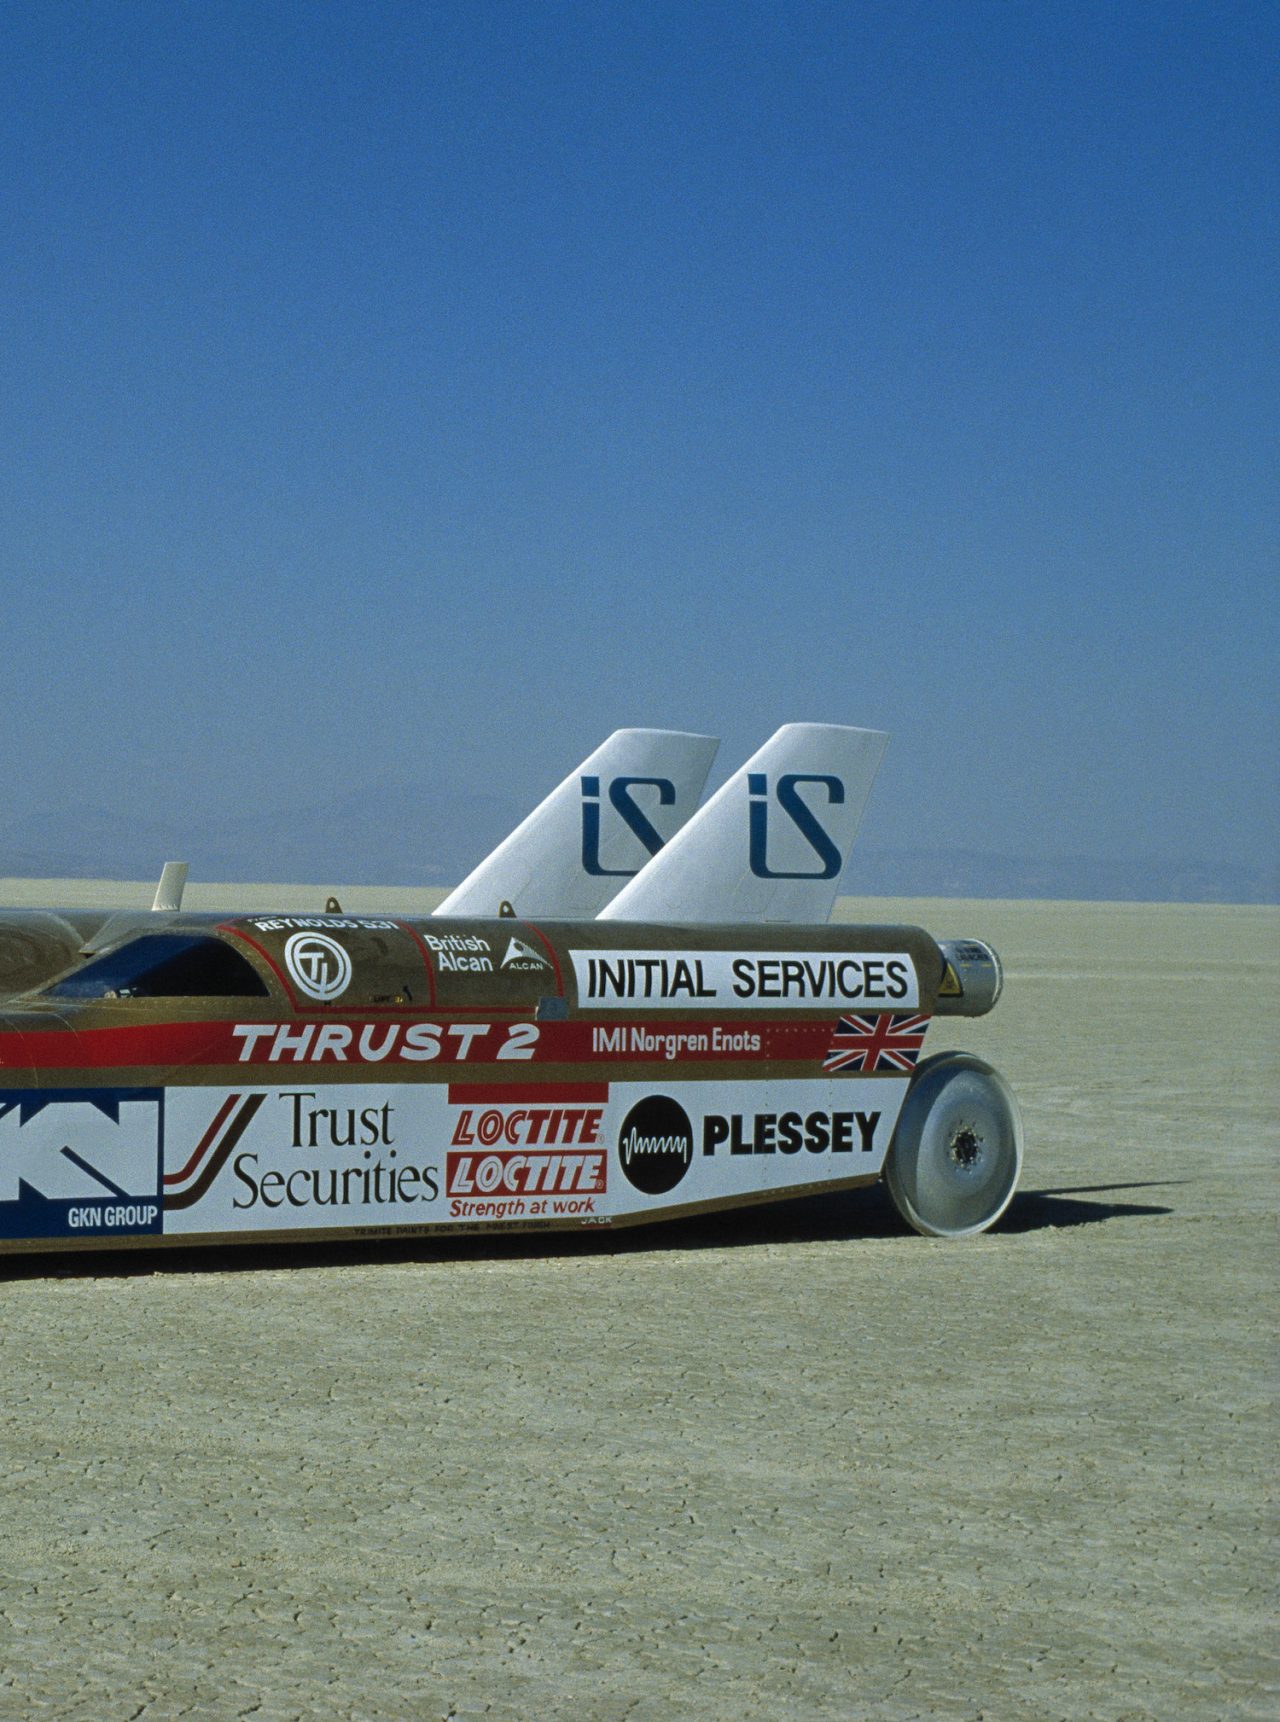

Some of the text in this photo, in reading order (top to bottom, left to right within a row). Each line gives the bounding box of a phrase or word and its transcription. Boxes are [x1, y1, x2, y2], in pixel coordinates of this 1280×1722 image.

[254, 917, 358, 932] REYNOLDS
[359, 919, 400, 930] 531
[423, 934, 491, 951] British
[438, 951, 494, 972] Alcan
[508, 962, 544, 970] ALCAN
[587, 958, 908, 999] INITIAL SERVICES
[232, 1022, 541, 1062] THRUST 2
[592, 1027, 761, 1060] IMI Norgren Enots
[279, 1092, 395, 1148] Trust
[702, 1110, 882, 1157] PLESSEY
[232, 1149, 439, 1210] Securities
[67, 1205, 158, 1228] GKN GROUP
[449, 1197, 596, 1219] Strength at work
[581, 1216, 612, 1225] JACK
